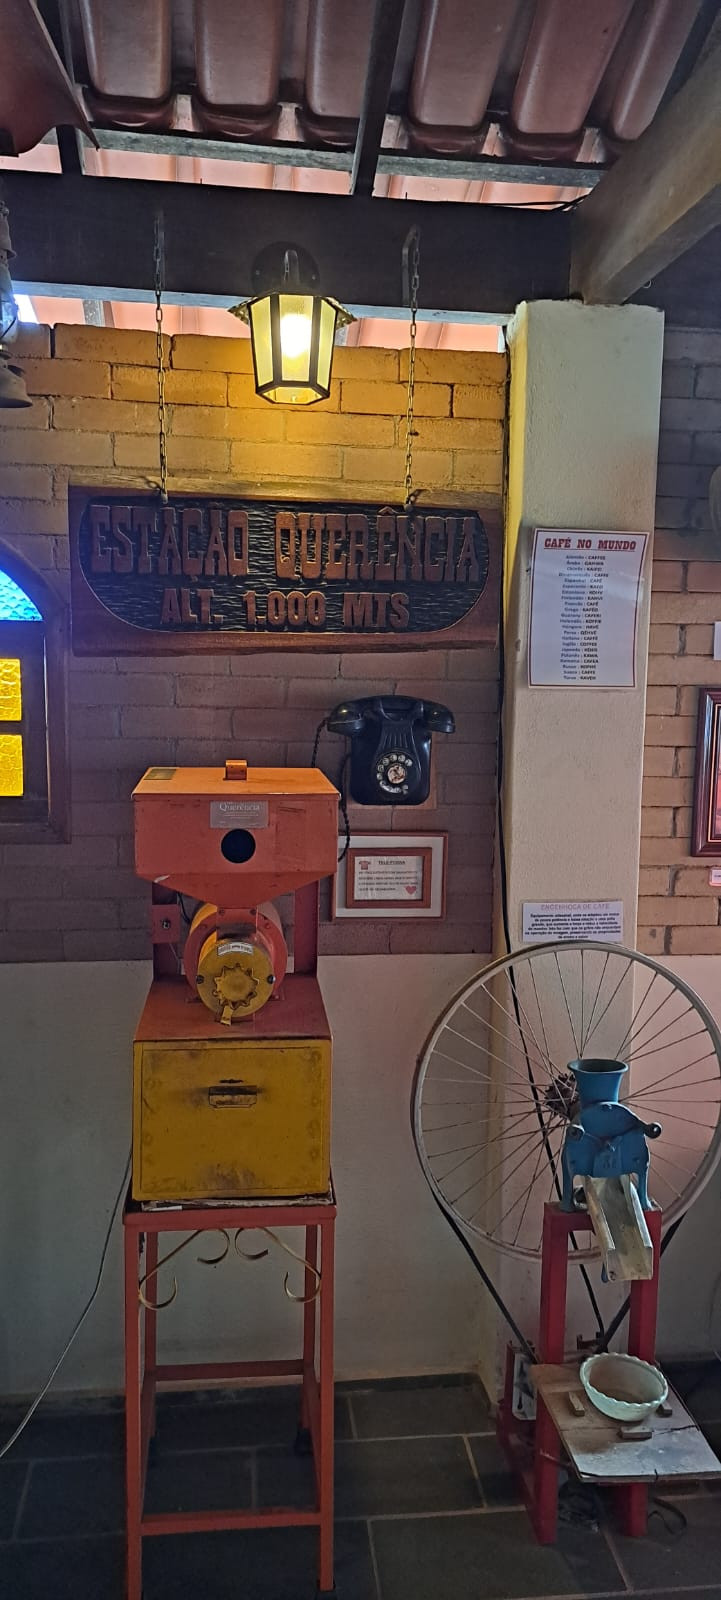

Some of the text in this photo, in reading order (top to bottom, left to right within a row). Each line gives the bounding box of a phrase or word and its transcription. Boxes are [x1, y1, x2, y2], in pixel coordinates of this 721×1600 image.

[274, 506, 480, 583] QUERÊNCIA
[544, 537, 637, 550] CAFÉ NO MUNDO
[160, 588, 411, 629] ALT. 1.000 MTS
